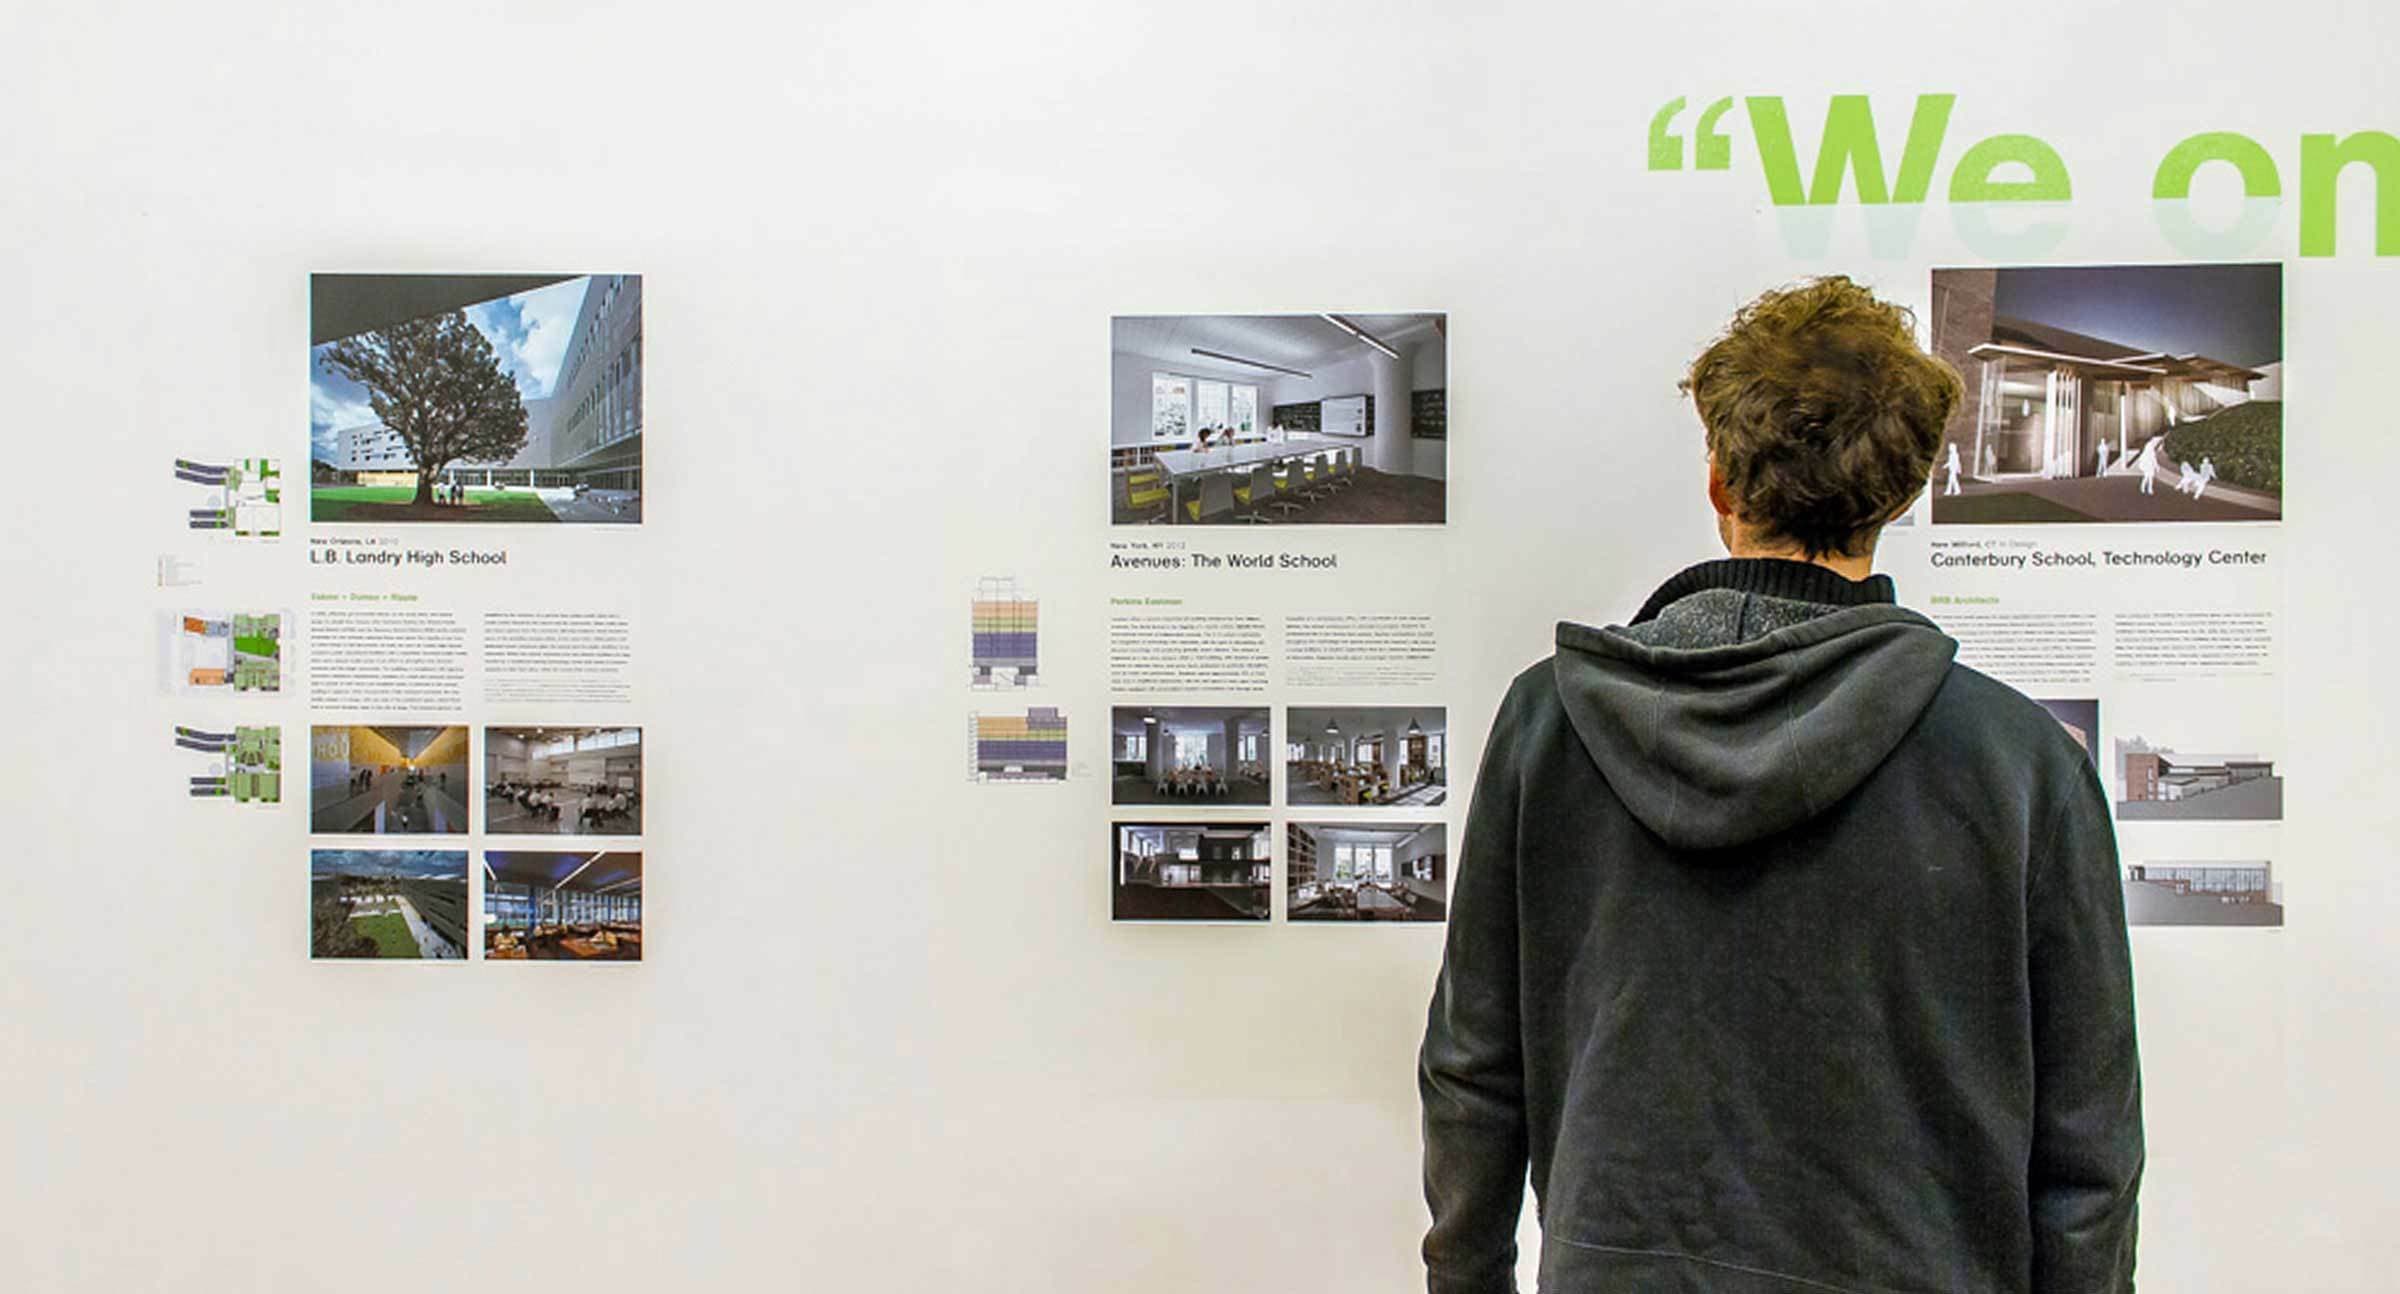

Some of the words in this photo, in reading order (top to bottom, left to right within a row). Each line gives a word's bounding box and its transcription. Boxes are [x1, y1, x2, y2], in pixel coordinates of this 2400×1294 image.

[310, 549, 341, 564] L.B.
[346, 549, 402, 567] Landry
[407, 549, 444, 567] High
[449, 549, 507, 565] School
[1111, 554, 1186, 568] Avenues:
[1191, 553, 1222, 568] The
[1227, 553, 1274, 568] World
[1279, 553, 1338, 568] School
[1930, 552, 2027, 568] Canterbury
[2032, 551, 2097, 567] School,
[2103, 550, 2203, 567] Technology
[2208, 550, 2267, 565] Center
